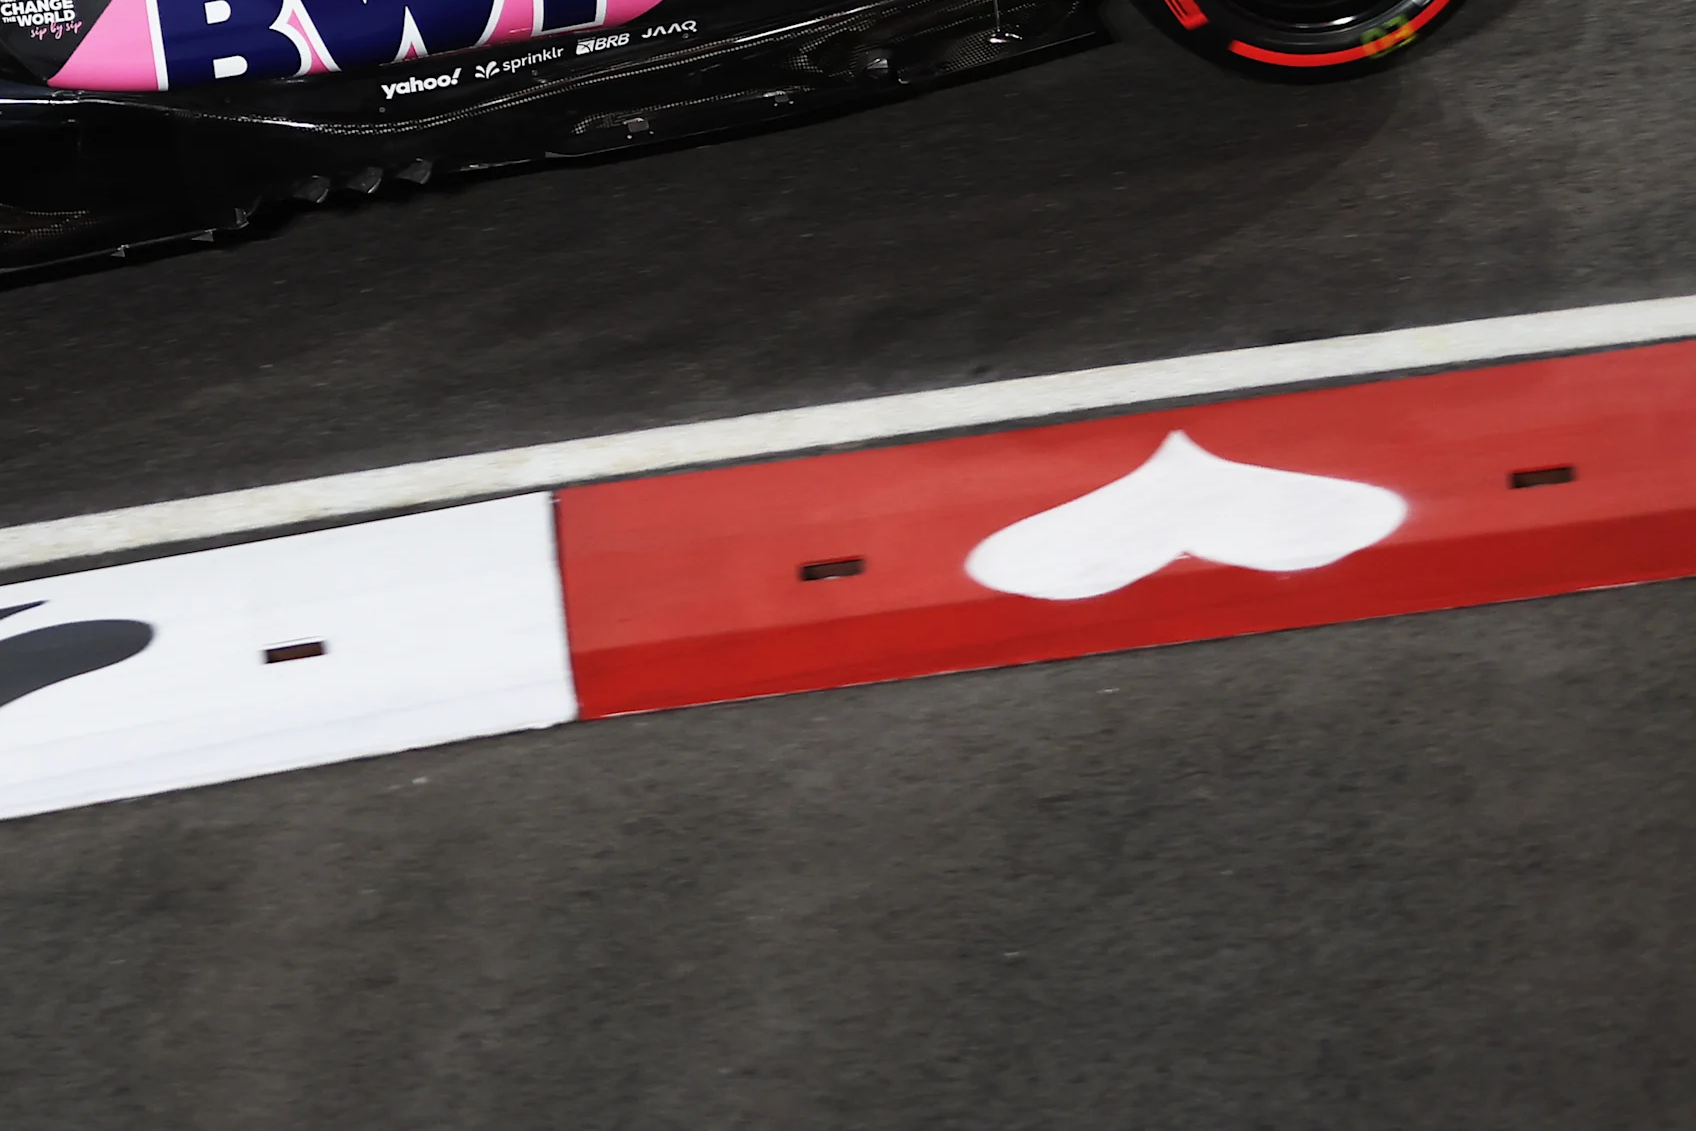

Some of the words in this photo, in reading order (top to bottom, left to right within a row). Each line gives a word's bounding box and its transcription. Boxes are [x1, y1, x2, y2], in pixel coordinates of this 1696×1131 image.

[2, 16, 17, 24] THE
[17, 9, 76, 27] WORLD
[30, 26, 47, 41] sip
[50, 21, 63, 40] by
[66, 21, 82, 34] sip
[594, 32, 631, 52] BRB
[502, 47, 565, 73] sprinklr
[380, 67, 463, 100] yahoo!
